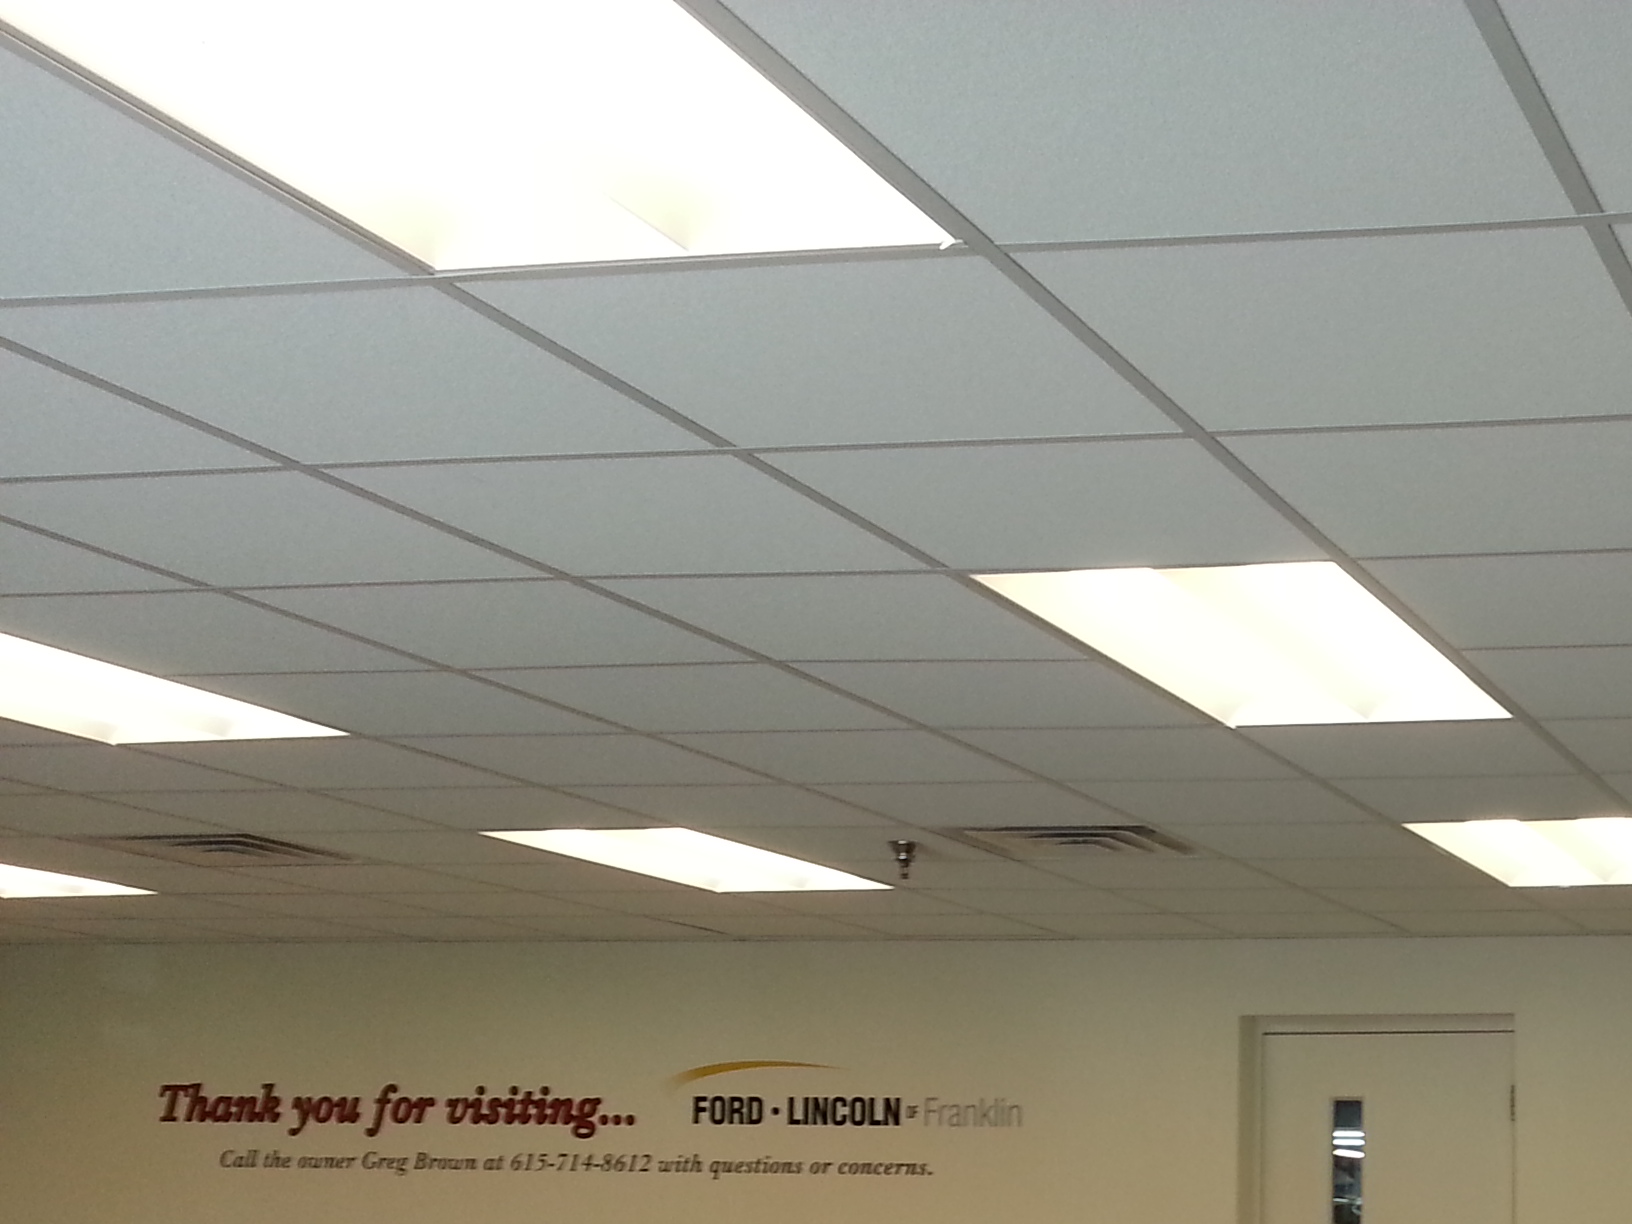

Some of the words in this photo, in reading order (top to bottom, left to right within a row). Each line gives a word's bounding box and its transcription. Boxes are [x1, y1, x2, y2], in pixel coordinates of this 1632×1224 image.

[160, 1083, 282, 1124] Thank
[288, 1094, 361, 1137] you
[365, 1084, 435, 1138] for
[446, 1086, 635, 1138] visiting...
[692, 1095, 764, 1126] FORD
[787, 1096, 901, 1127] LINCOLN
[924, 1097, 1023, 1127] Franklin
[219, 1149, 258, 1168] Call
[263, 1150, 291, 1169] the
[297, 1155, 356, 1169] owner
[361, 1151, 407, 1176] Greg
[413, 1153, 476, 1171] Brown
[483, 1154, 504, 1171] at
[510, 1153, 651, 1173] 615-714-8612
[658, 1154, 702, 1173] with
[709, 1155, 802, 1179] questions
[810, 1160, 831, 1175] or
[838, 1160, 934, 1176] concerns.
